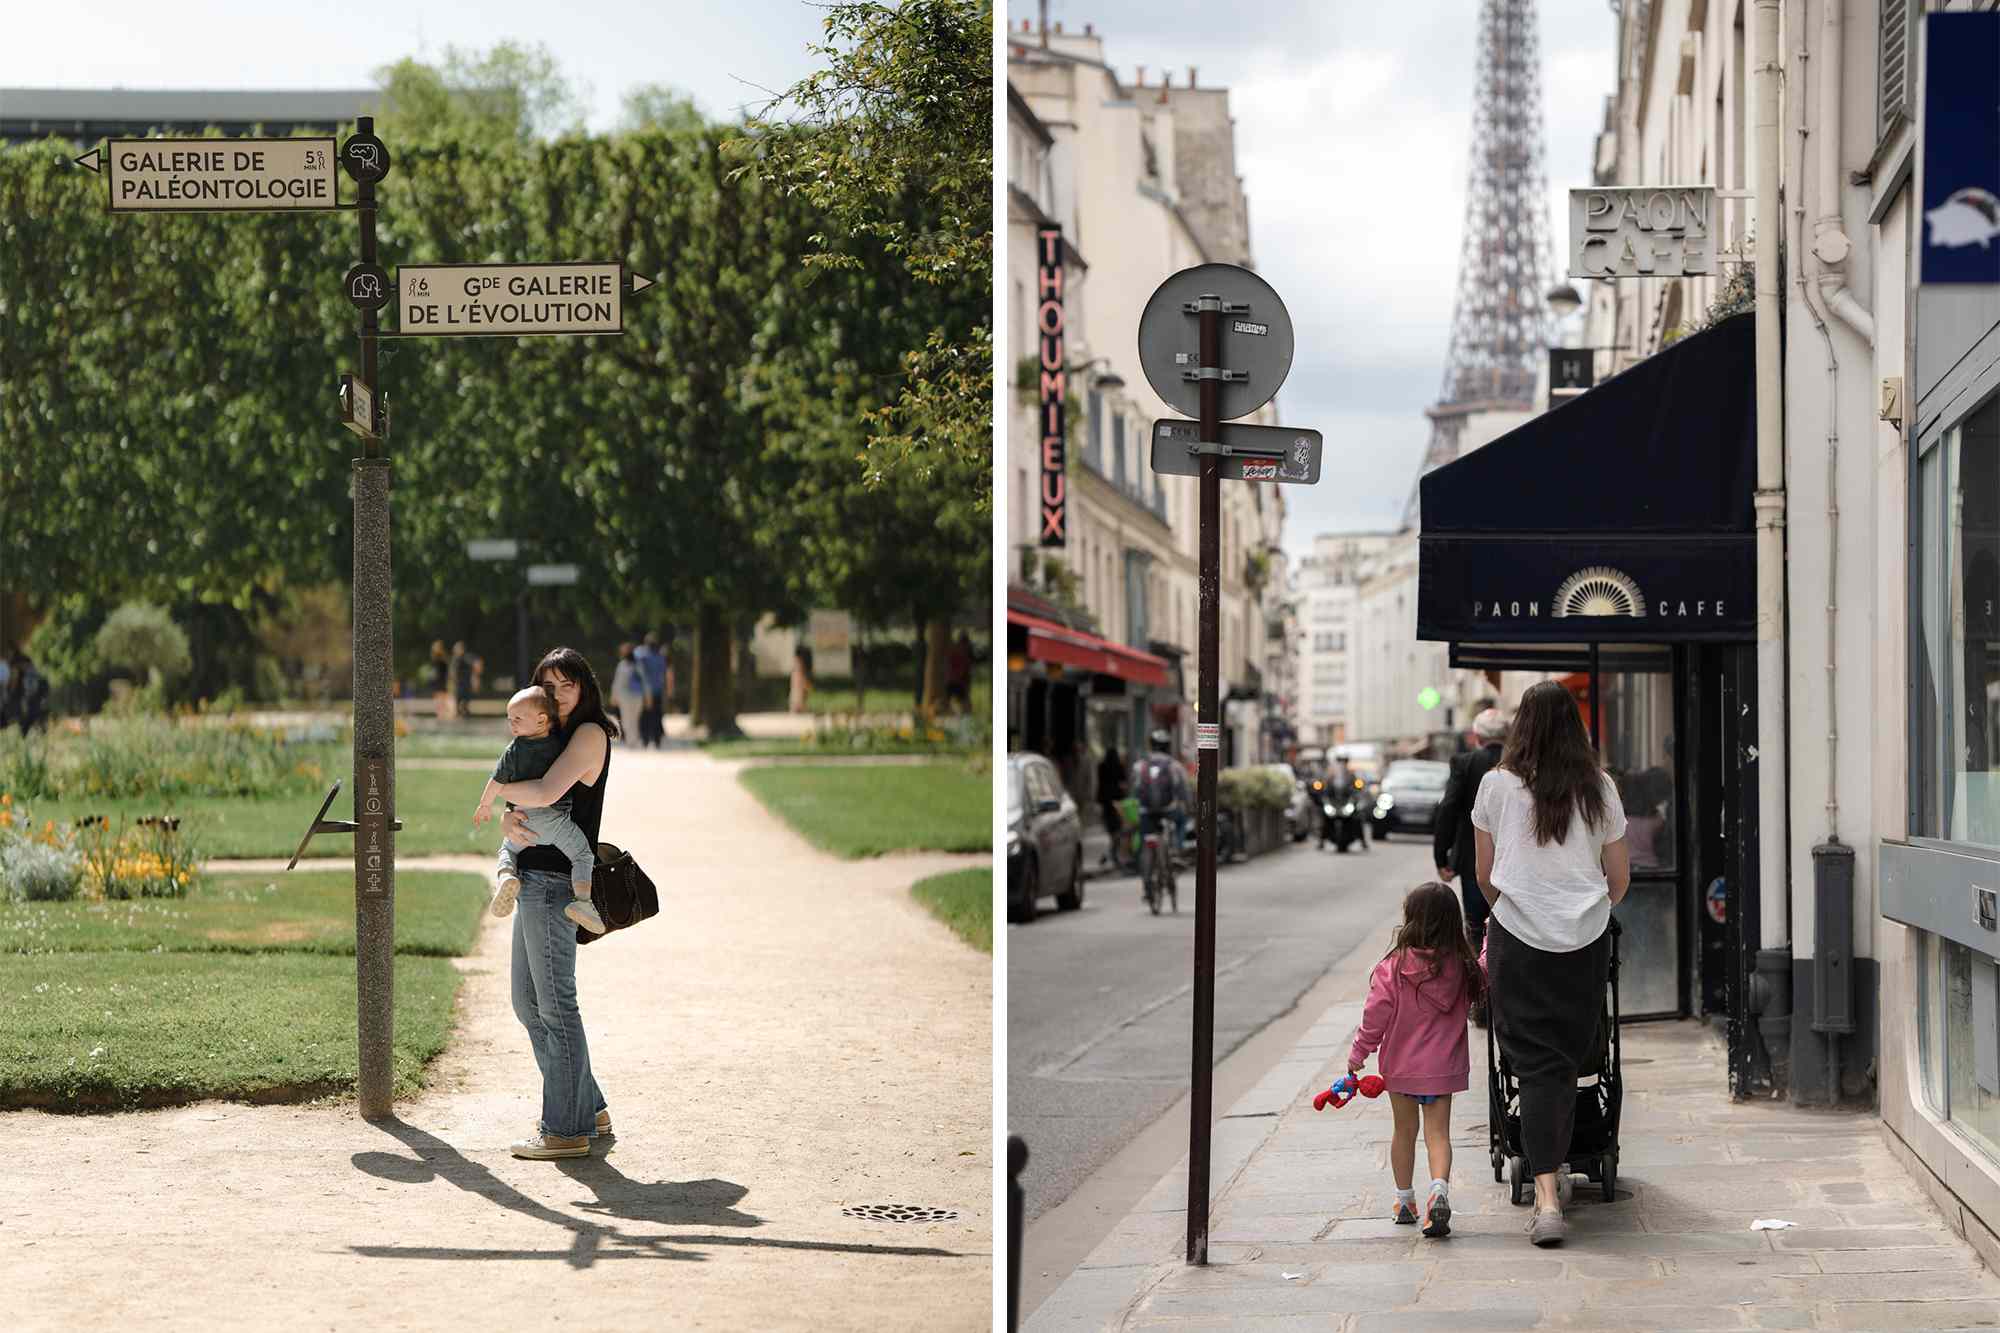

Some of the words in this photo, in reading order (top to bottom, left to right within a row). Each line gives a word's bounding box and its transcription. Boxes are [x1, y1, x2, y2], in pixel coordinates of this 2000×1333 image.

[120, 152, 225, 172] GALERIE
[233, 151, 265, 172] DE
[305, 151, 315, 164] 5
[121, 174, 327, 200] PALÉONTOLOGIE
[1585, 191, 1707, 232] PAON
[418, 277, 429, 291] 6
[508, 275, 612, 297] GALERIE
[408, 304, 439, 325] DE
[447, 298, 612, 325] L'ÉVOLUTION
[1039, 230, 1064, 538] THOUMIEUX
[1474, 601, 1539, 617] PAON
[1659, 600, 1725, 617] CAFE
